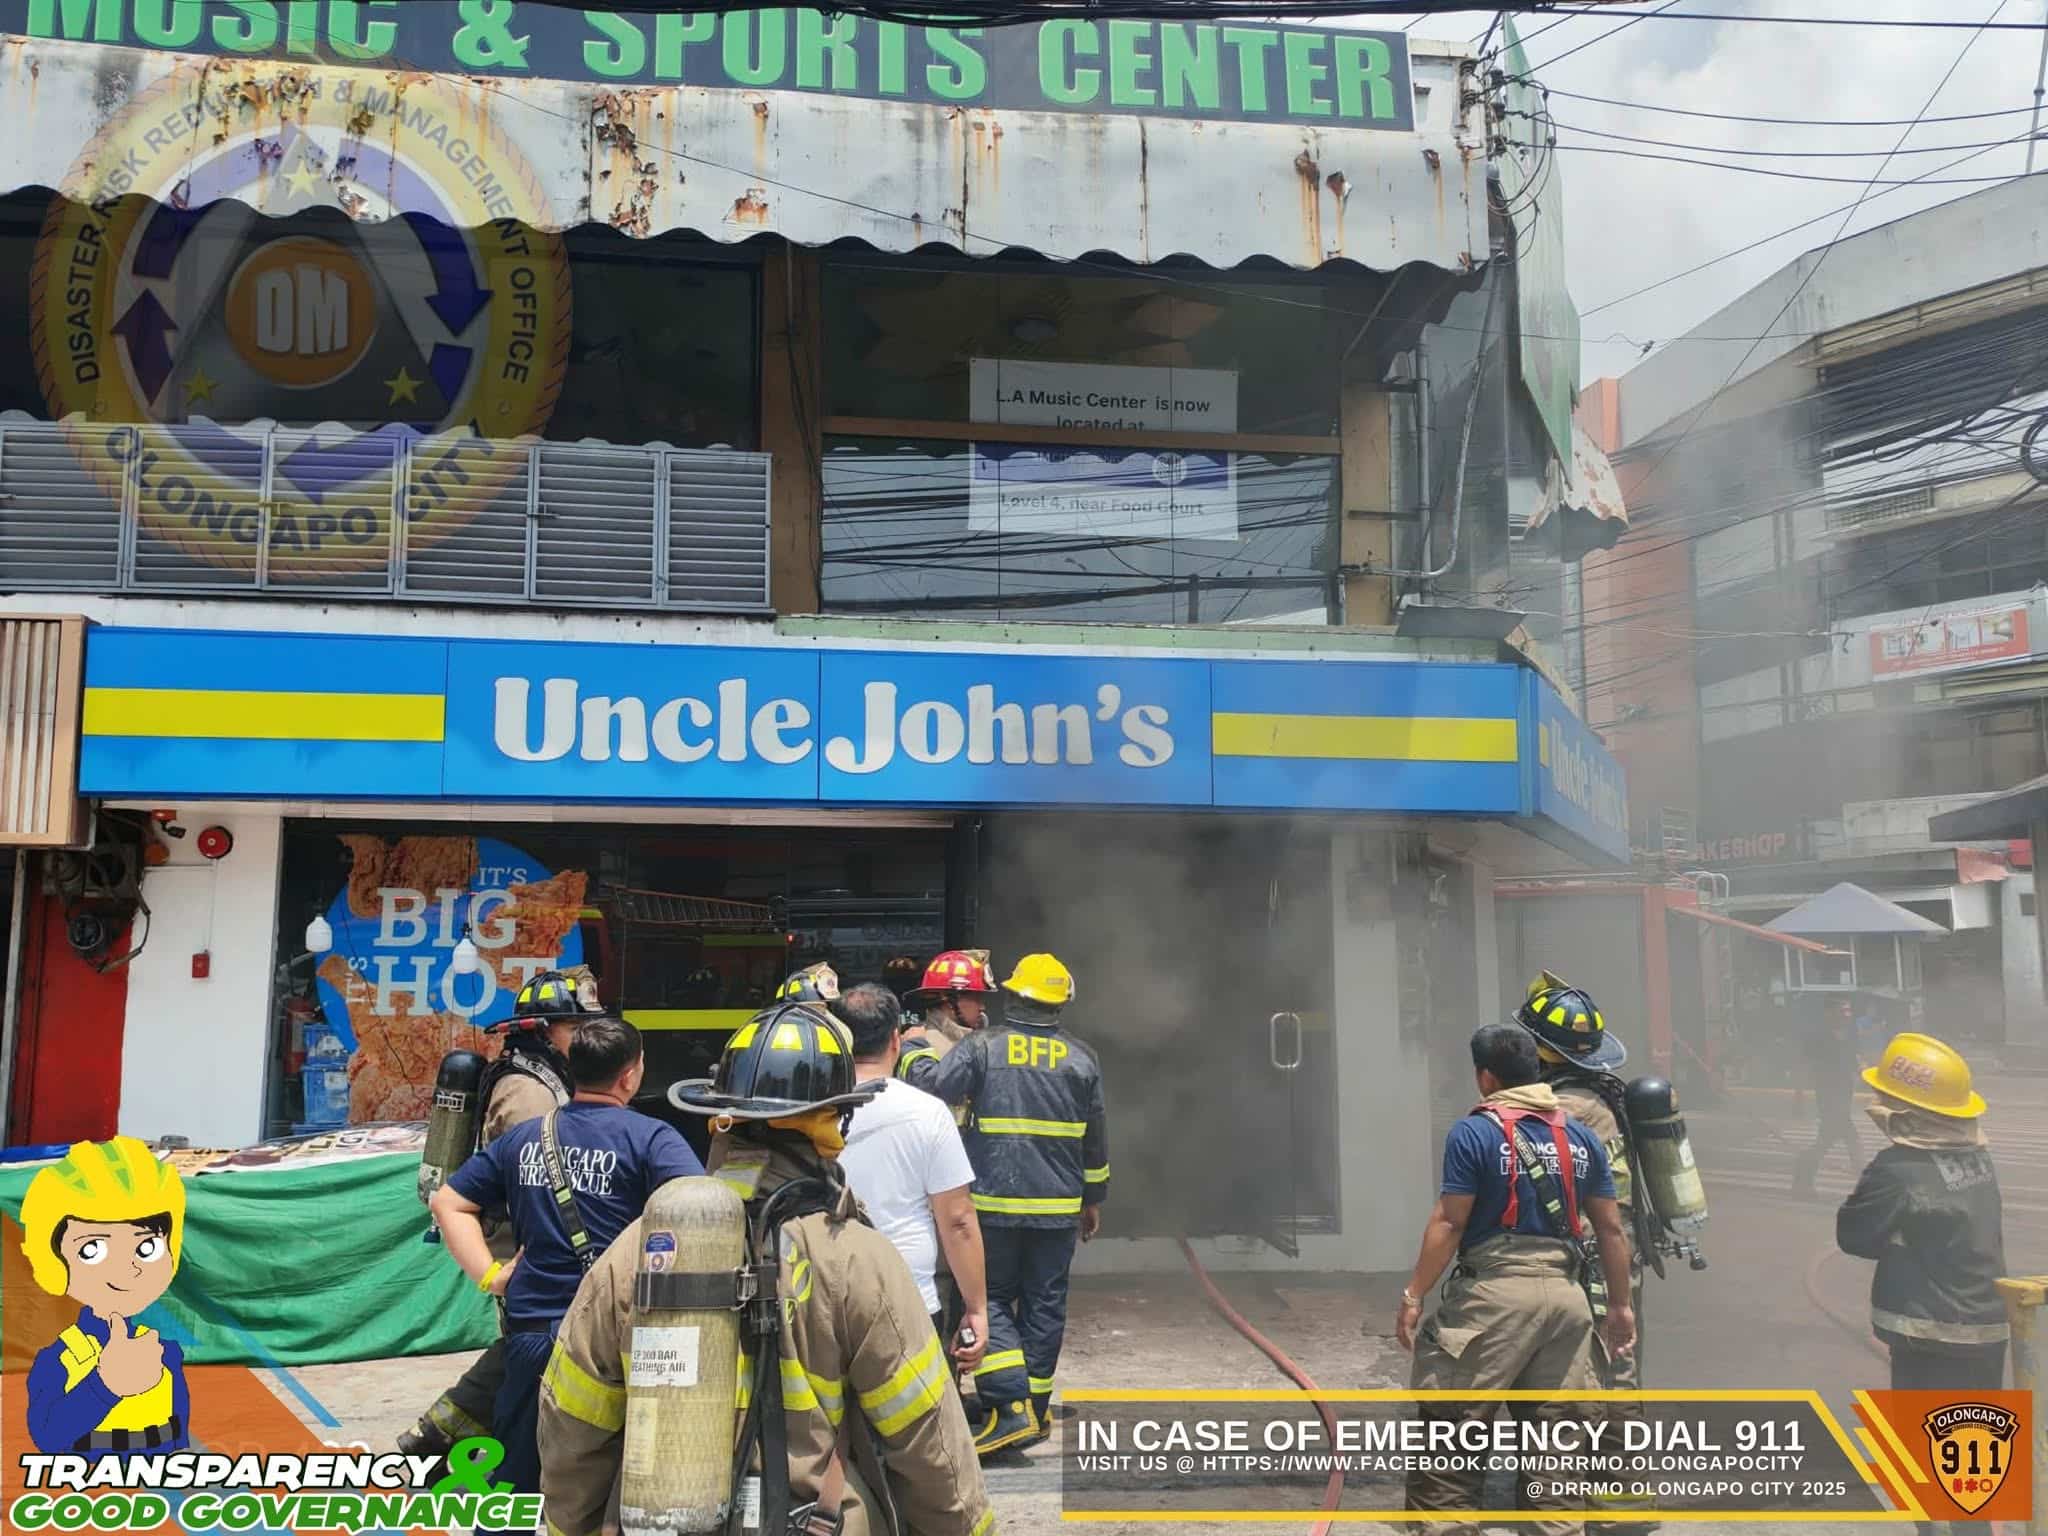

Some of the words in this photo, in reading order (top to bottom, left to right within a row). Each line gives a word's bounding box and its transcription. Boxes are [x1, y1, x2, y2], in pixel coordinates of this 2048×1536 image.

[452, 0, 530, 69] &
[583, 8, 987, 98] SPORTS
[1037, 17, 1396, 119] CENTER
[1029, 389, 1081, 406] Music
[1086, 392, 1147, 410] Center
[1155, 396, 1169, 411] is
[1174, 399, 1211, 412] now
[1056, 416, 1123, 432] located
[1128, 419, 1145, 433] at
[1001, 493, 1046, 509] Level
[1069, 498, 1107, 512] near
[494, 676, 815, 764] Uncle
[825, 680, 1175, 774] John's
[479, 867, 528, 886] IT'S
[373, 887, 518, 949] BIG
[346, 956, 369, 1005] IT'S
[369, 955, 558, 1017] HOT
[900, 1010, 920, 1025] n's
[1008, 1034, 1068, 1069] BFP
[519, 1142, 617, 1174] OLNGAPO
[1499, 1142, 1588, 1160] ONGPO
[518, 1164, 547, 1186] FIRE
